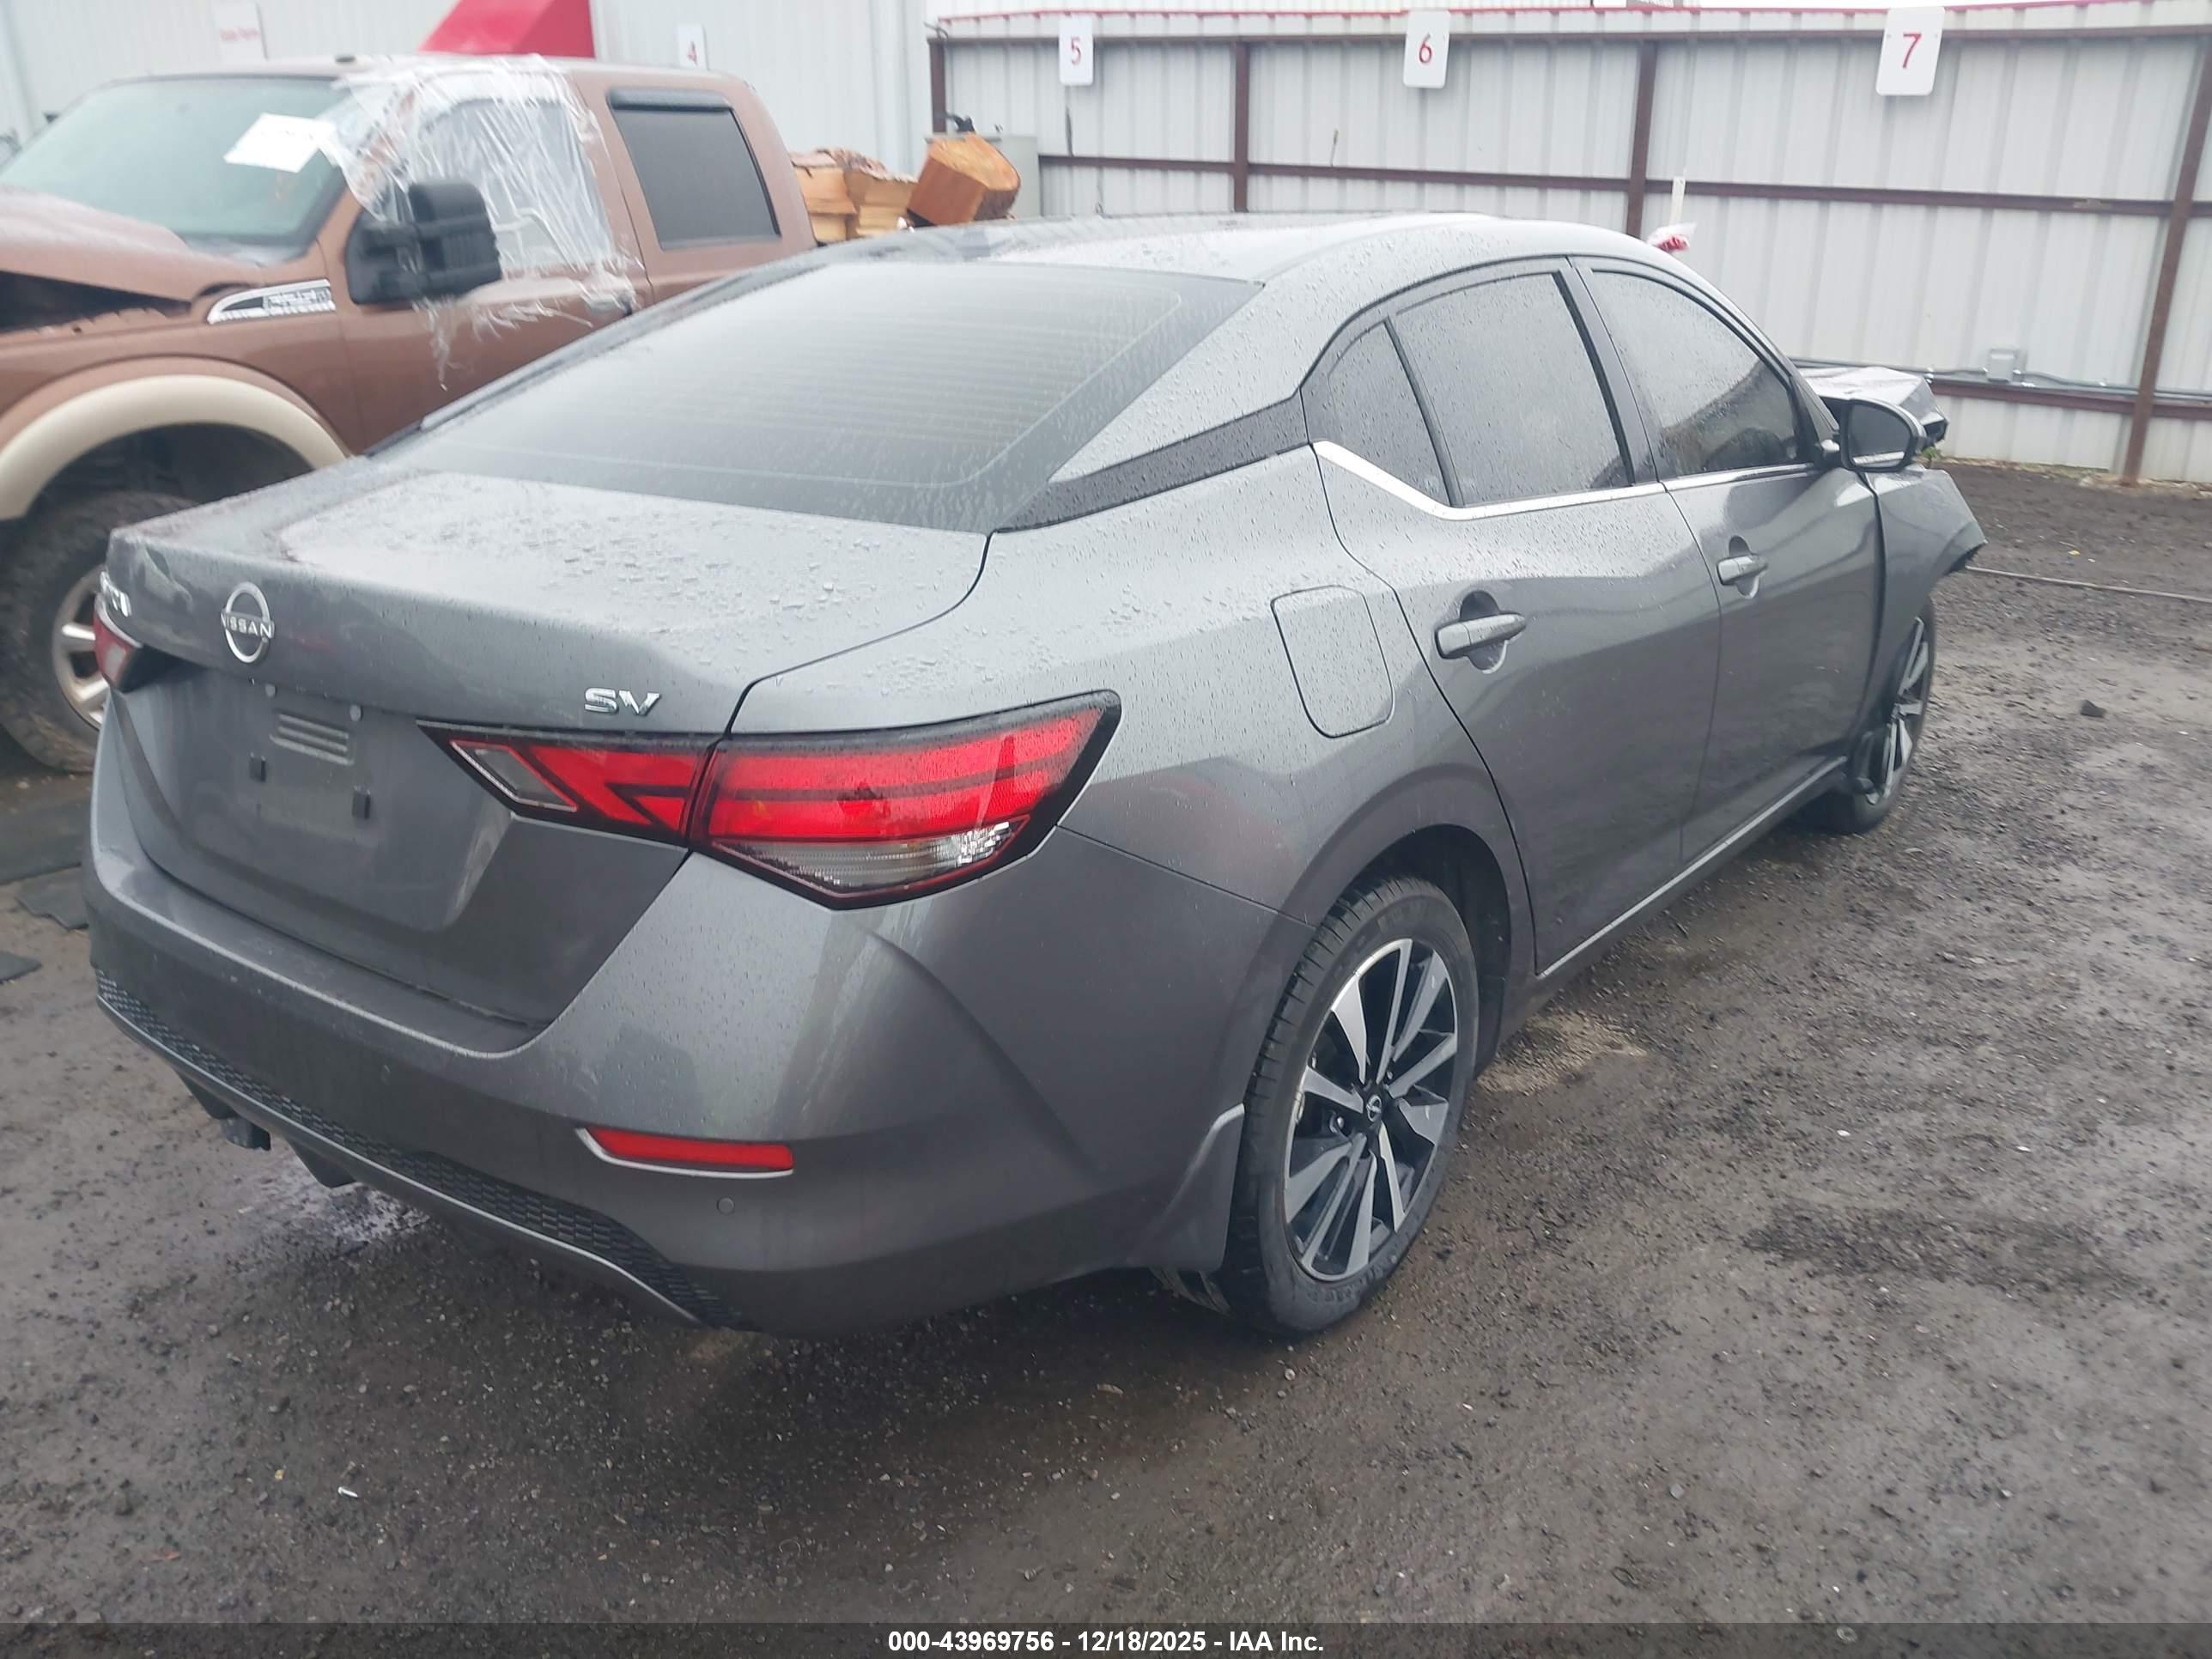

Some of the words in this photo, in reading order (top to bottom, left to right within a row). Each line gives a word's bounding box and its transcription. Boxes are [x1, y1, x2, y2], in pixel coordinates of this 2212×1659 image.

[1071, 37, 1081, 64] 5
[1419, 33, 1431, 64] 6
[1902, 33, 1922, 69] 7
[221, 610, 275, 639] NISSAN
[584, 688, 660, 716] SV
